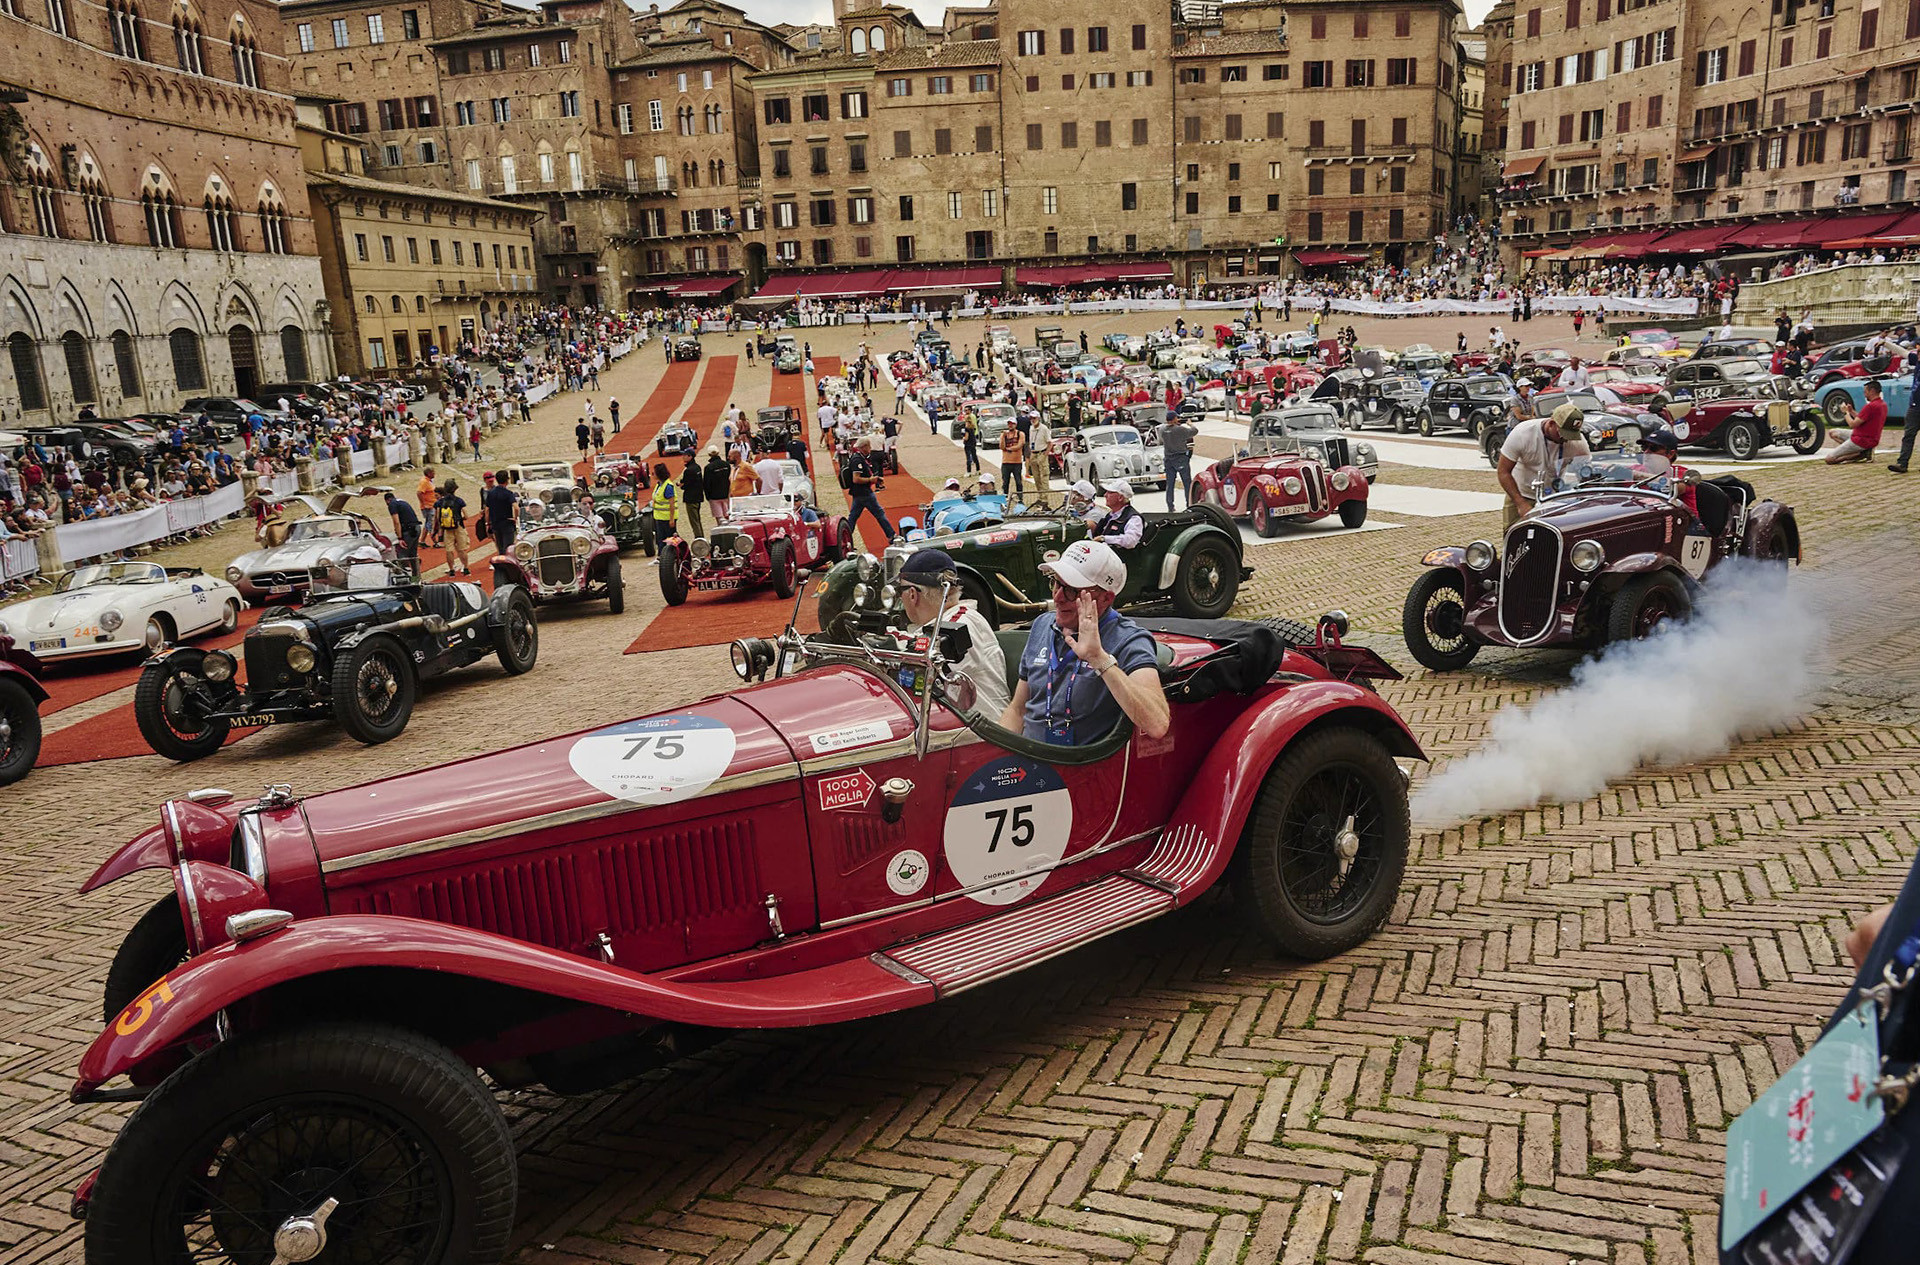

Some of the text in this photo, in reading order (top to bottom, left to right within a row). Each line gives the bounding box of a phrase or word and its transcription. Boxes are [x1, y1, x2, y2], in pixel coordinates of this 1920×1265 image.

[1601, 430, 1614, 438] 247
[1691, 540, 1705, 559] 87
[720, 579, 739, 589] 697
[1105, 575, 1114, 586] 75
[73, 625, 99, 638] 245
[229, 713, 276, 727] MV2792
[621, 735, 685, 760] 75
[991, 774, 1010, 782] MIGLIA
[826, 778, 860, 793] 1000
[825, 790, 864, 806] MIGLIA
[984, 804, 1035, 853] 75
[983, 868, 1016, 881] CHOPARD
